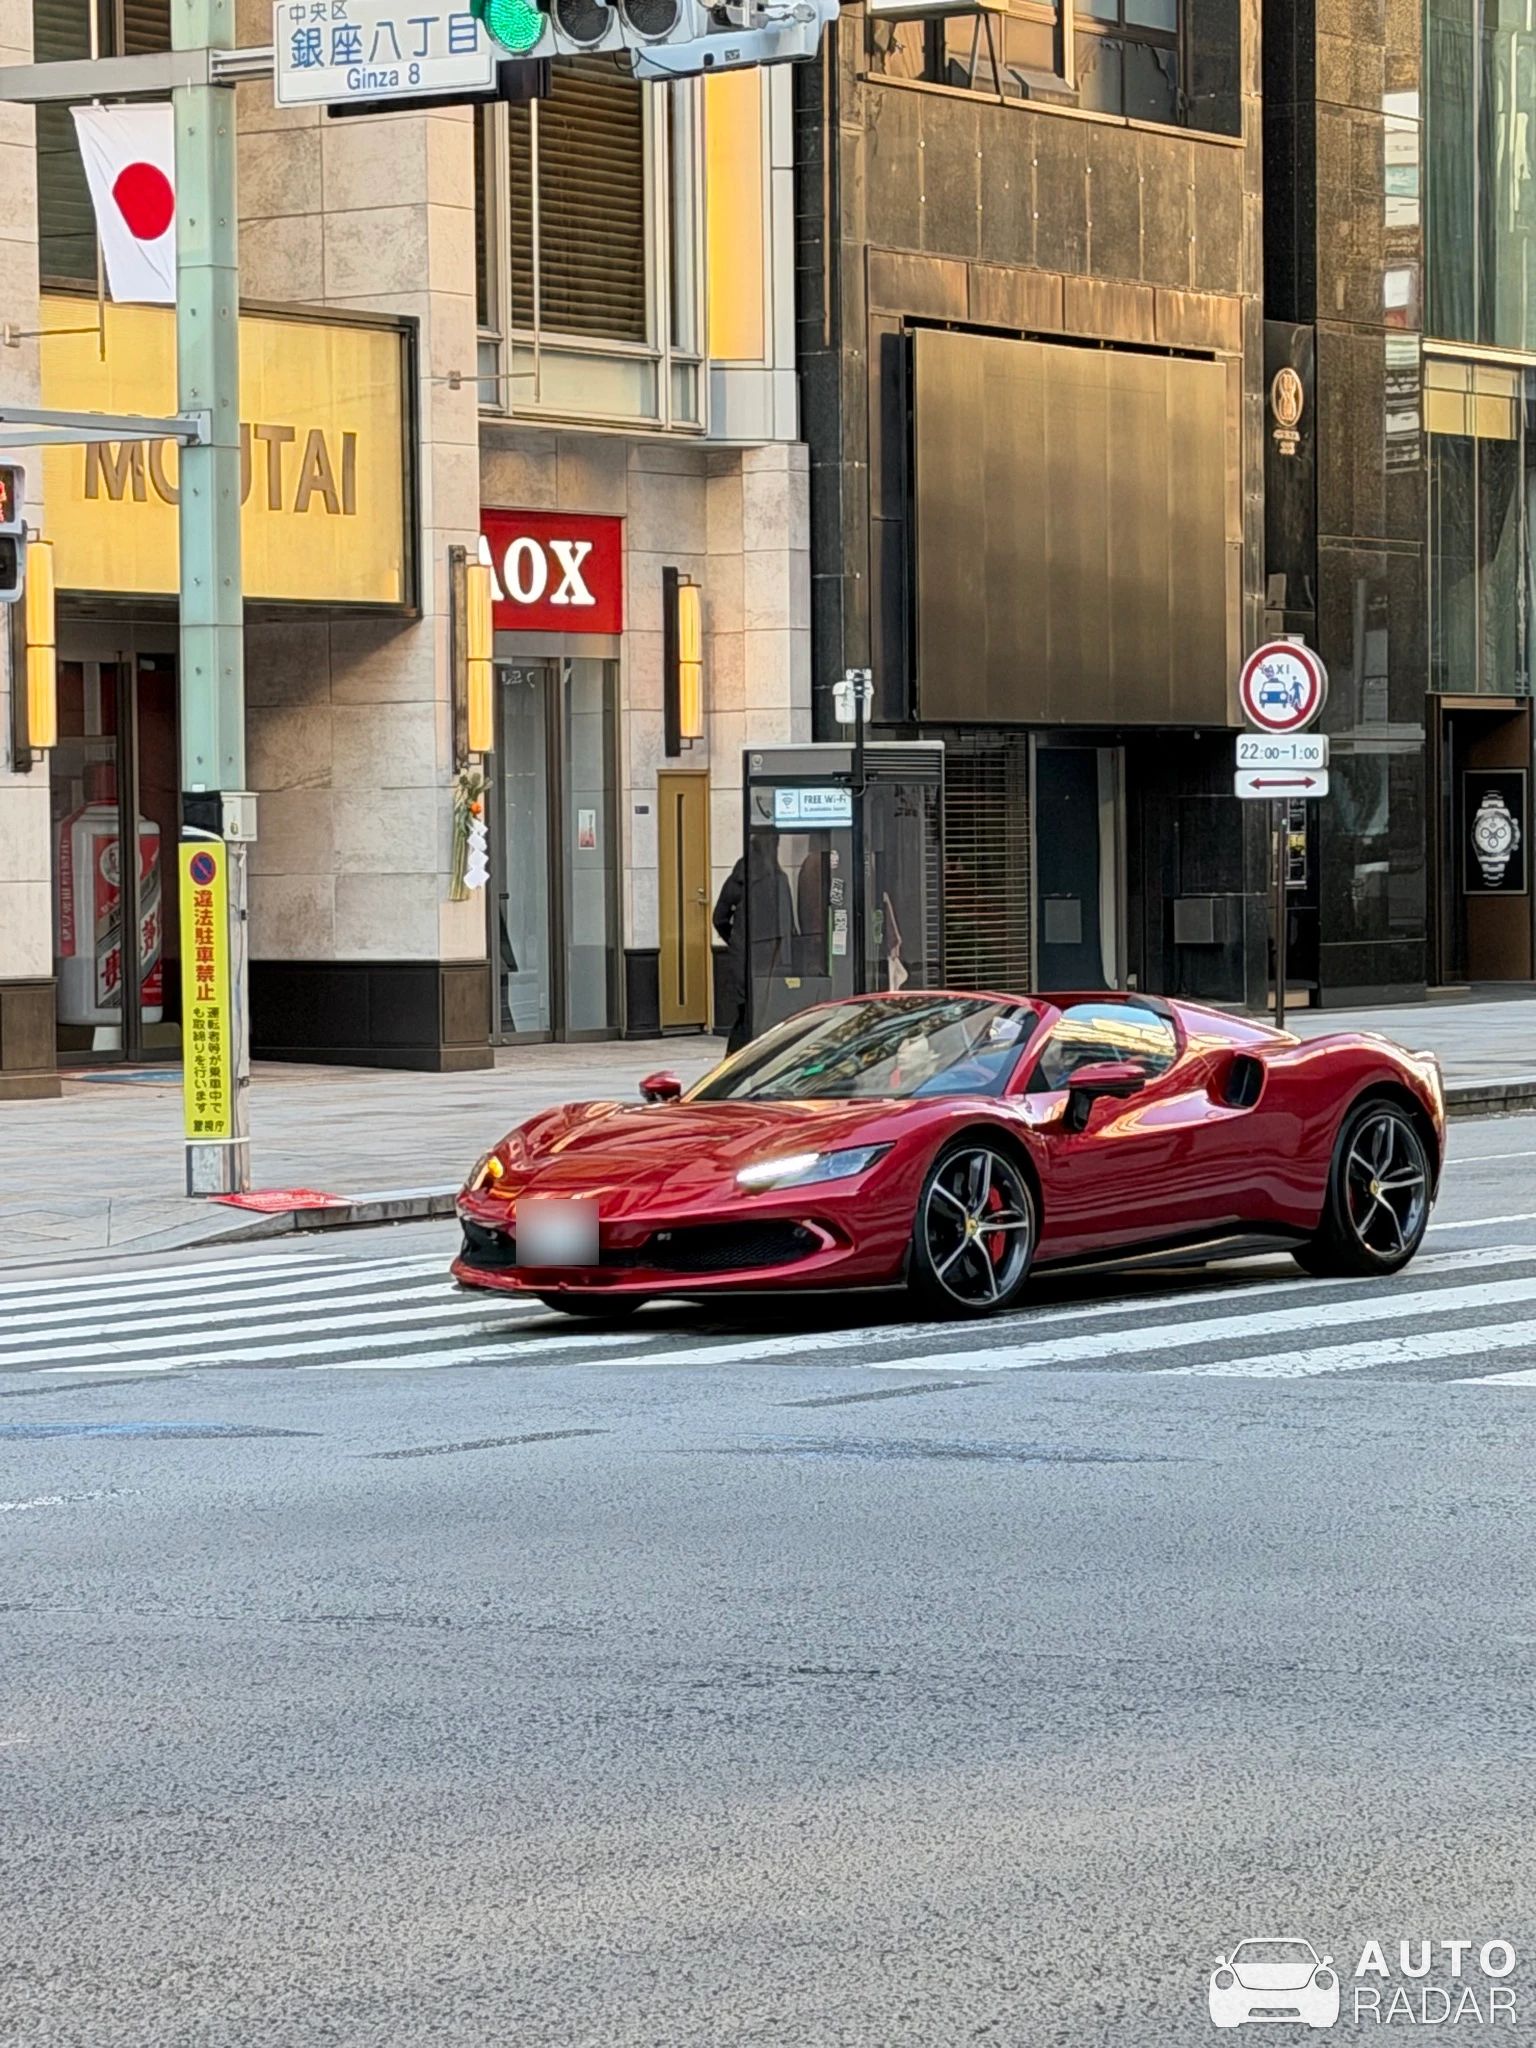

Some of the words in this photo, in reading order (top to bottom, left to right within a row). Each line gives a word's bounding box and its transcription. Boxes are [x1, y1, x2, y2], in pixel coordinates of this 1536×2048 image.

[289, 1, 347, 25] 中央区
[290, 13, 478, 69] 銀座八丁目
[347, 66, 399, 90] Ginza
[408, 63, 421, 84] 8
[84, 411, 357, 516] MTAI
[1240, 742, 1319, 760] 22:00-1:00
[804, 794, 822, 804] FREE
[824, 793, 847, 804] Wi-Fi
[193, 889, 216, 1001] 違法駐車禁止
[192, 1006, 208, 1114] も取締りを行います
[193, 1119, 225, 1132] 警視庁
